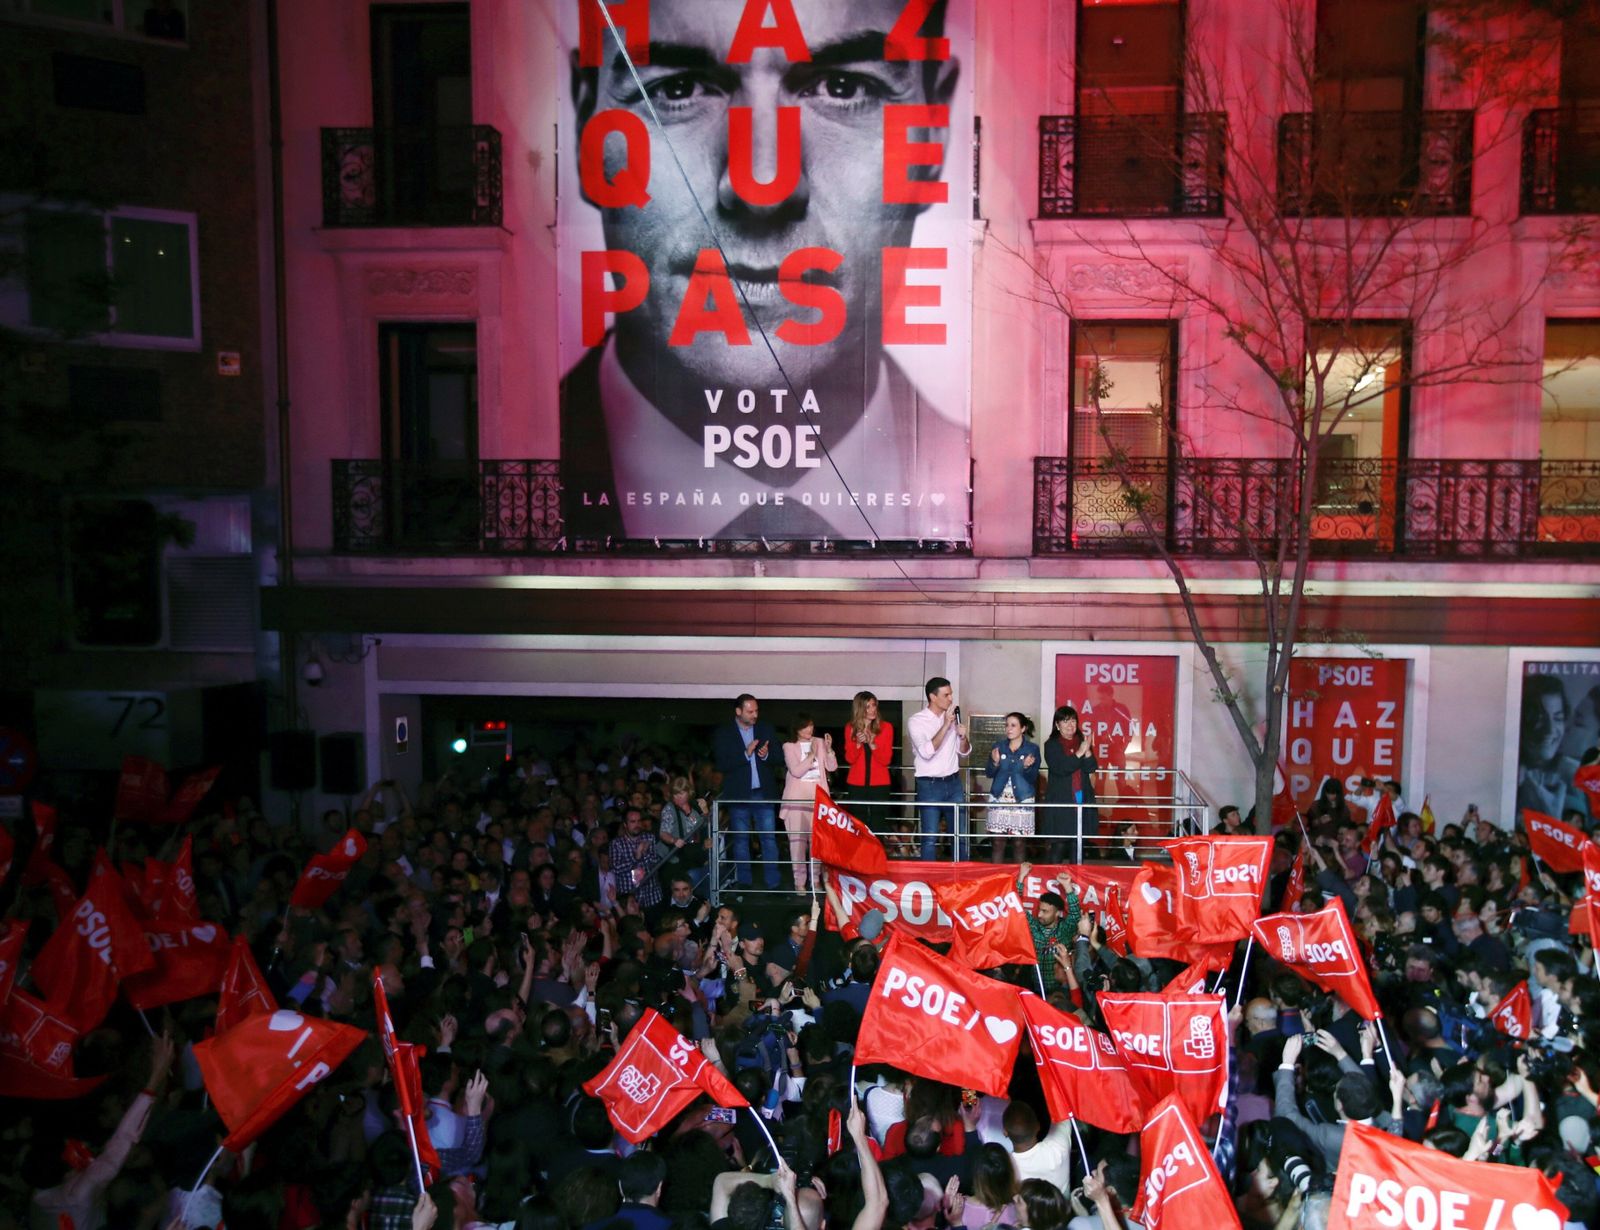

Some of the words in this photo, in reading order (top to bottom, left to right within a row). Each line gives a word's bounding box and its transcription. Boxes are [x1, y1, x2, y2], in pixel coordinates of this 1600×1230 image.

[578, 0, 950, 67] HAZ
[579, 104, 949, 210] QUE
[580, 246, 948, 348] PASE
[704, 389, 821, 414] VOTA
[703, 424, 821, 469] PSOE
[583, 492, 611, 507] LA
[626, 488, 723, 507] ESPAÑA
[739, 492, 785, 507] QUE
[1084, 663, 1140, 684] PSOE
[1318, 665, 1375, 687] PSOE
[108, 697, 165, 736] 72
[1080, 718, 1158, 737] SPAÑA
[1292, 700, 1396, 729] HAZ
[1290, 738, 1394, 766] QUE
[1530, 819, 1576, 848] PSOE
[881, 966, 967, 1027] PSOE
[1499, 1005, 1523, 1037] PSO
[1345, 1172, 1471, 1230] PSOE
